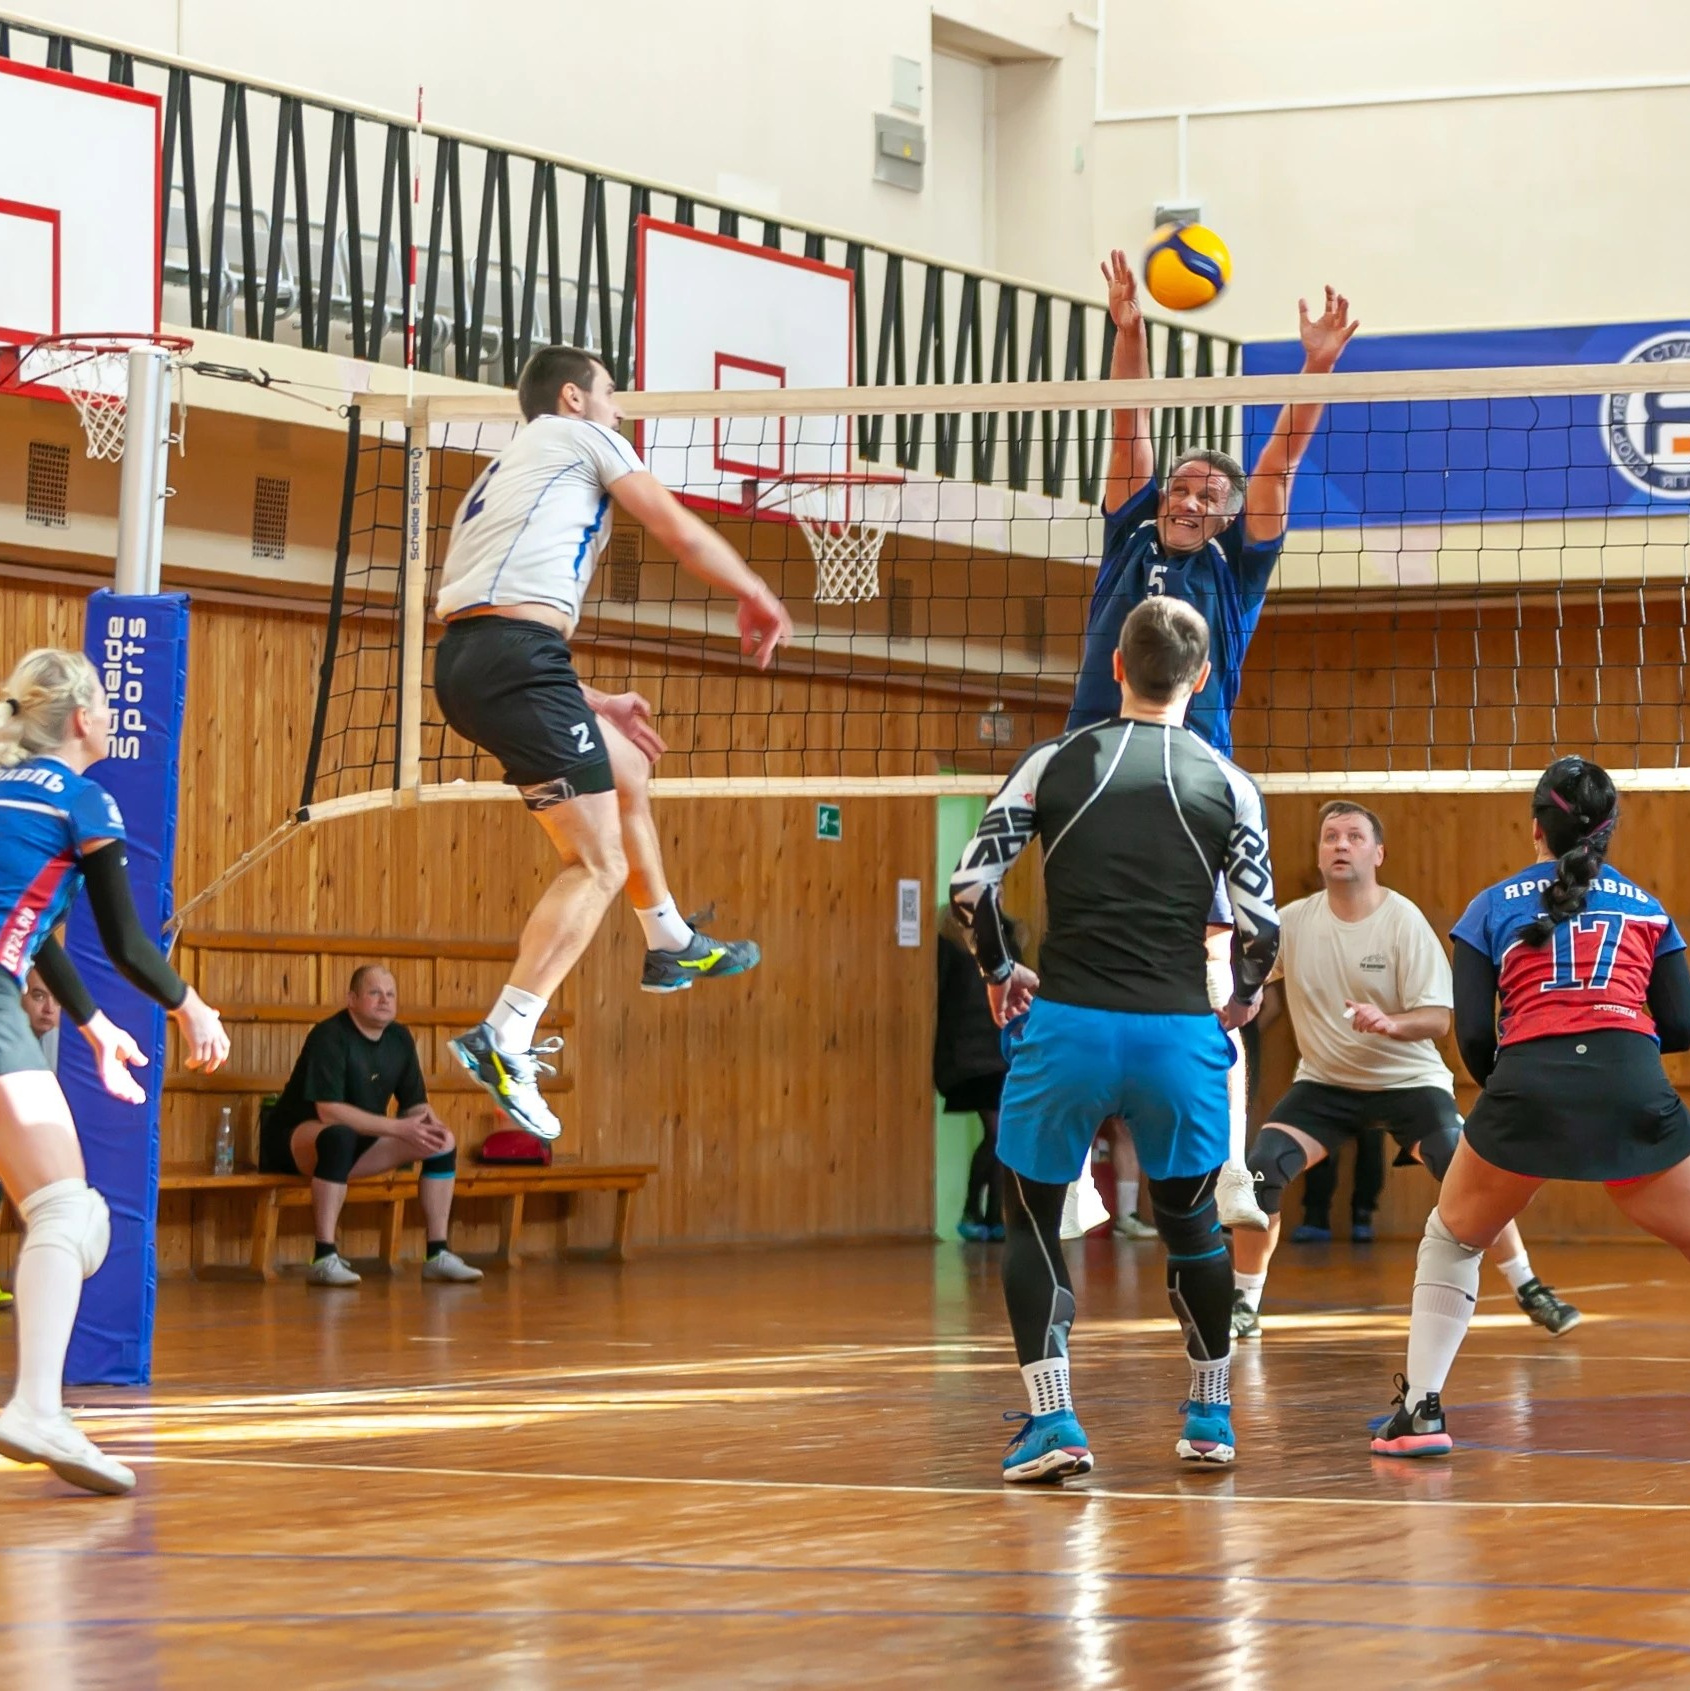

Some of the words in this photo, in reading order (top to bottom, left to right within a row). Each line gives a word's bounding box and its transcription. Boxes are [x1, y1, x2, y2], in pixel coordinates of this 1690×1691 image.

[410, 461, 422, 505] Sports
[410, 508, 420, 560] Schelde
[1147, 564, 1169, 600] 5
[117, 617, 147, 760] Sports
[569, 722, 596, 753] 2
[0, 768, 65, 793] АВЛЬ
[1503, 877, 1650, 904] ЯРОАВЛЬ
[1539, 909, 1627, 993] 17
